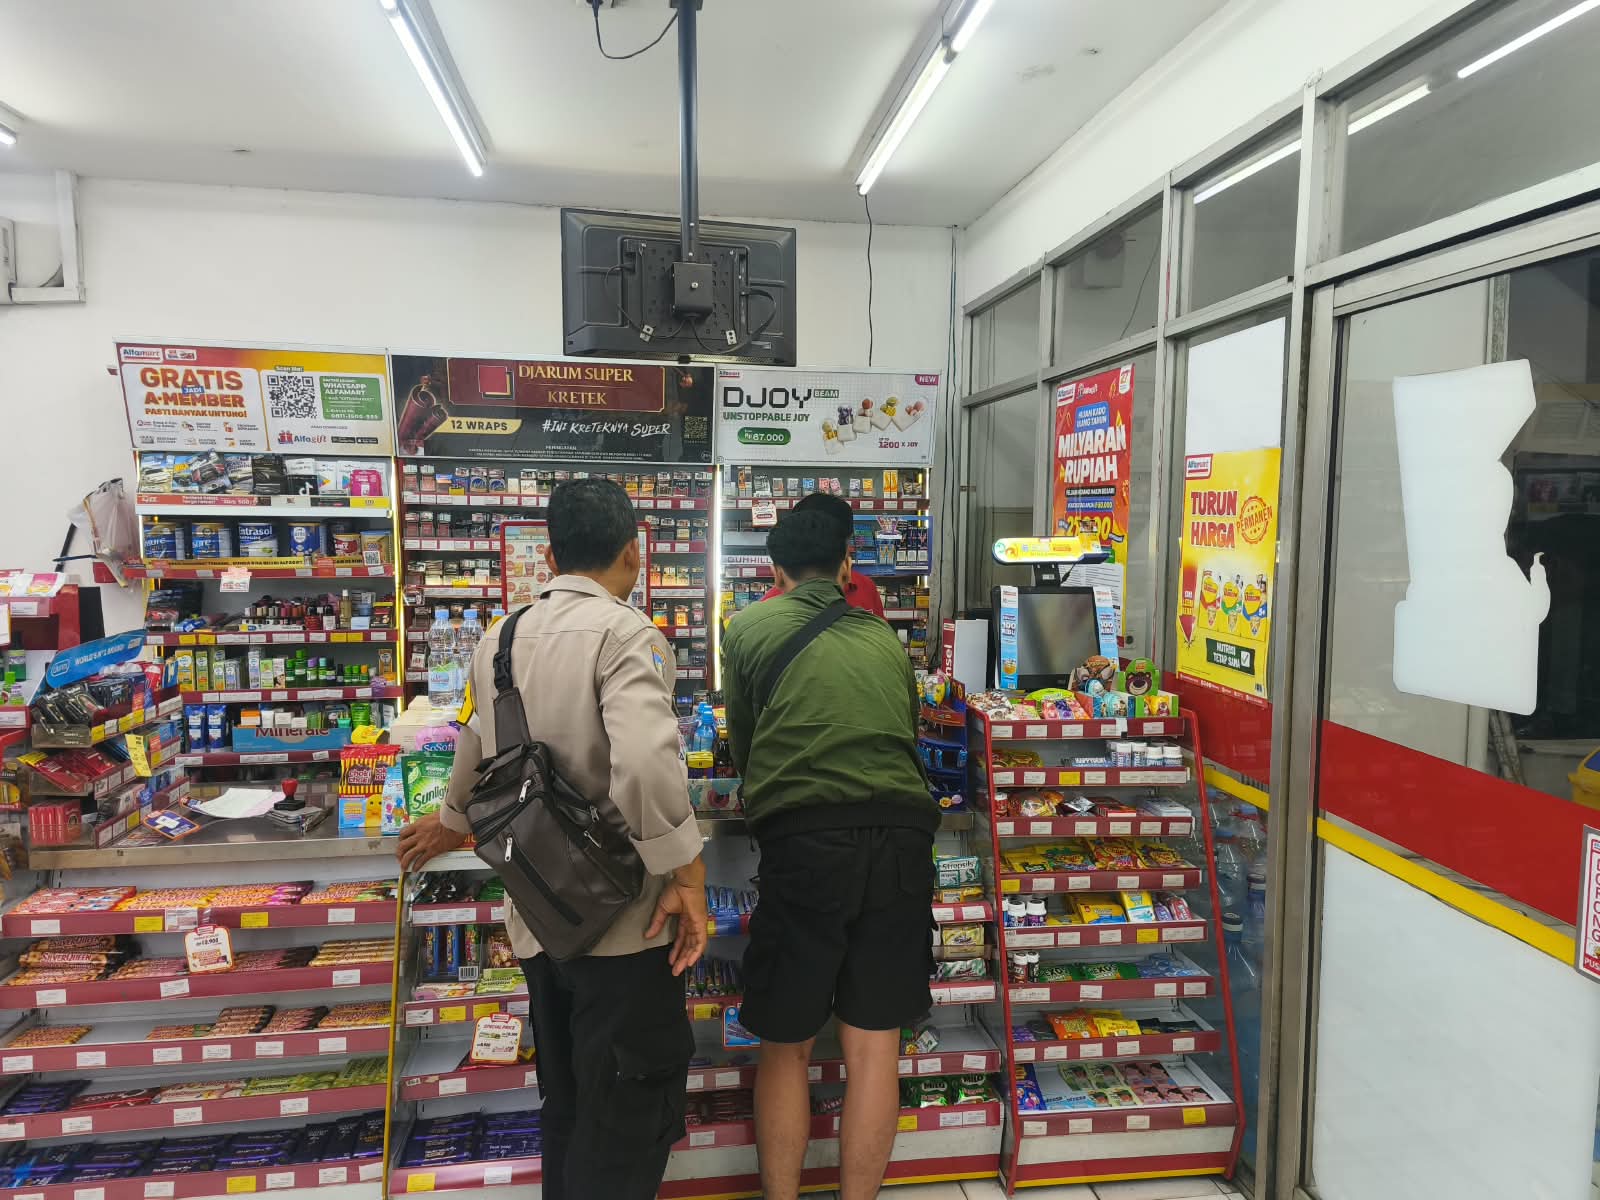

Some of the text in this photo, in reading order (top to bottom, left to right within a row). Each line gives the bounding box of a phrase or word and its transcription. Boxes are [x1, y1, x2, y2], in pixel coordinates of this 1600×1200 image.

[123, 348, 159, 357] Alfamart
[140, 367, 243, 390] GRATIS
[518, 365, 634, 382] DJARUM SUPER
[919, 375, 936, 383] NEW
[548, 391, 607, 405] KRETEK
[723, 387, 839, 409] DJOY BEAM
[145, 408, 247, 418] PASTI BANYAK UNTUNG!
[723, 411, 810, 422] UNSTOPPABLE JOY
[451, 419, 508, 432] 12 WRAPS
[1058, 424, 1127, 458] MILYARAN
[1064, 455, 1118, 484] RUPIAH
[1191, 490, 1237, 516] TURUN
[1236, 505, 1273, 533] PERMANEN
[1191, 521, 1235, 548] HARGA
[1216, 641, 1236, 656] NUTRISI
[1213, 652, 1241, 669] TETAP SAMA
[942, 860, 974, 869] Stropsils
[923, 1081, 946, 1089] MILO
[963, 1073, 984, 1082] MILO
